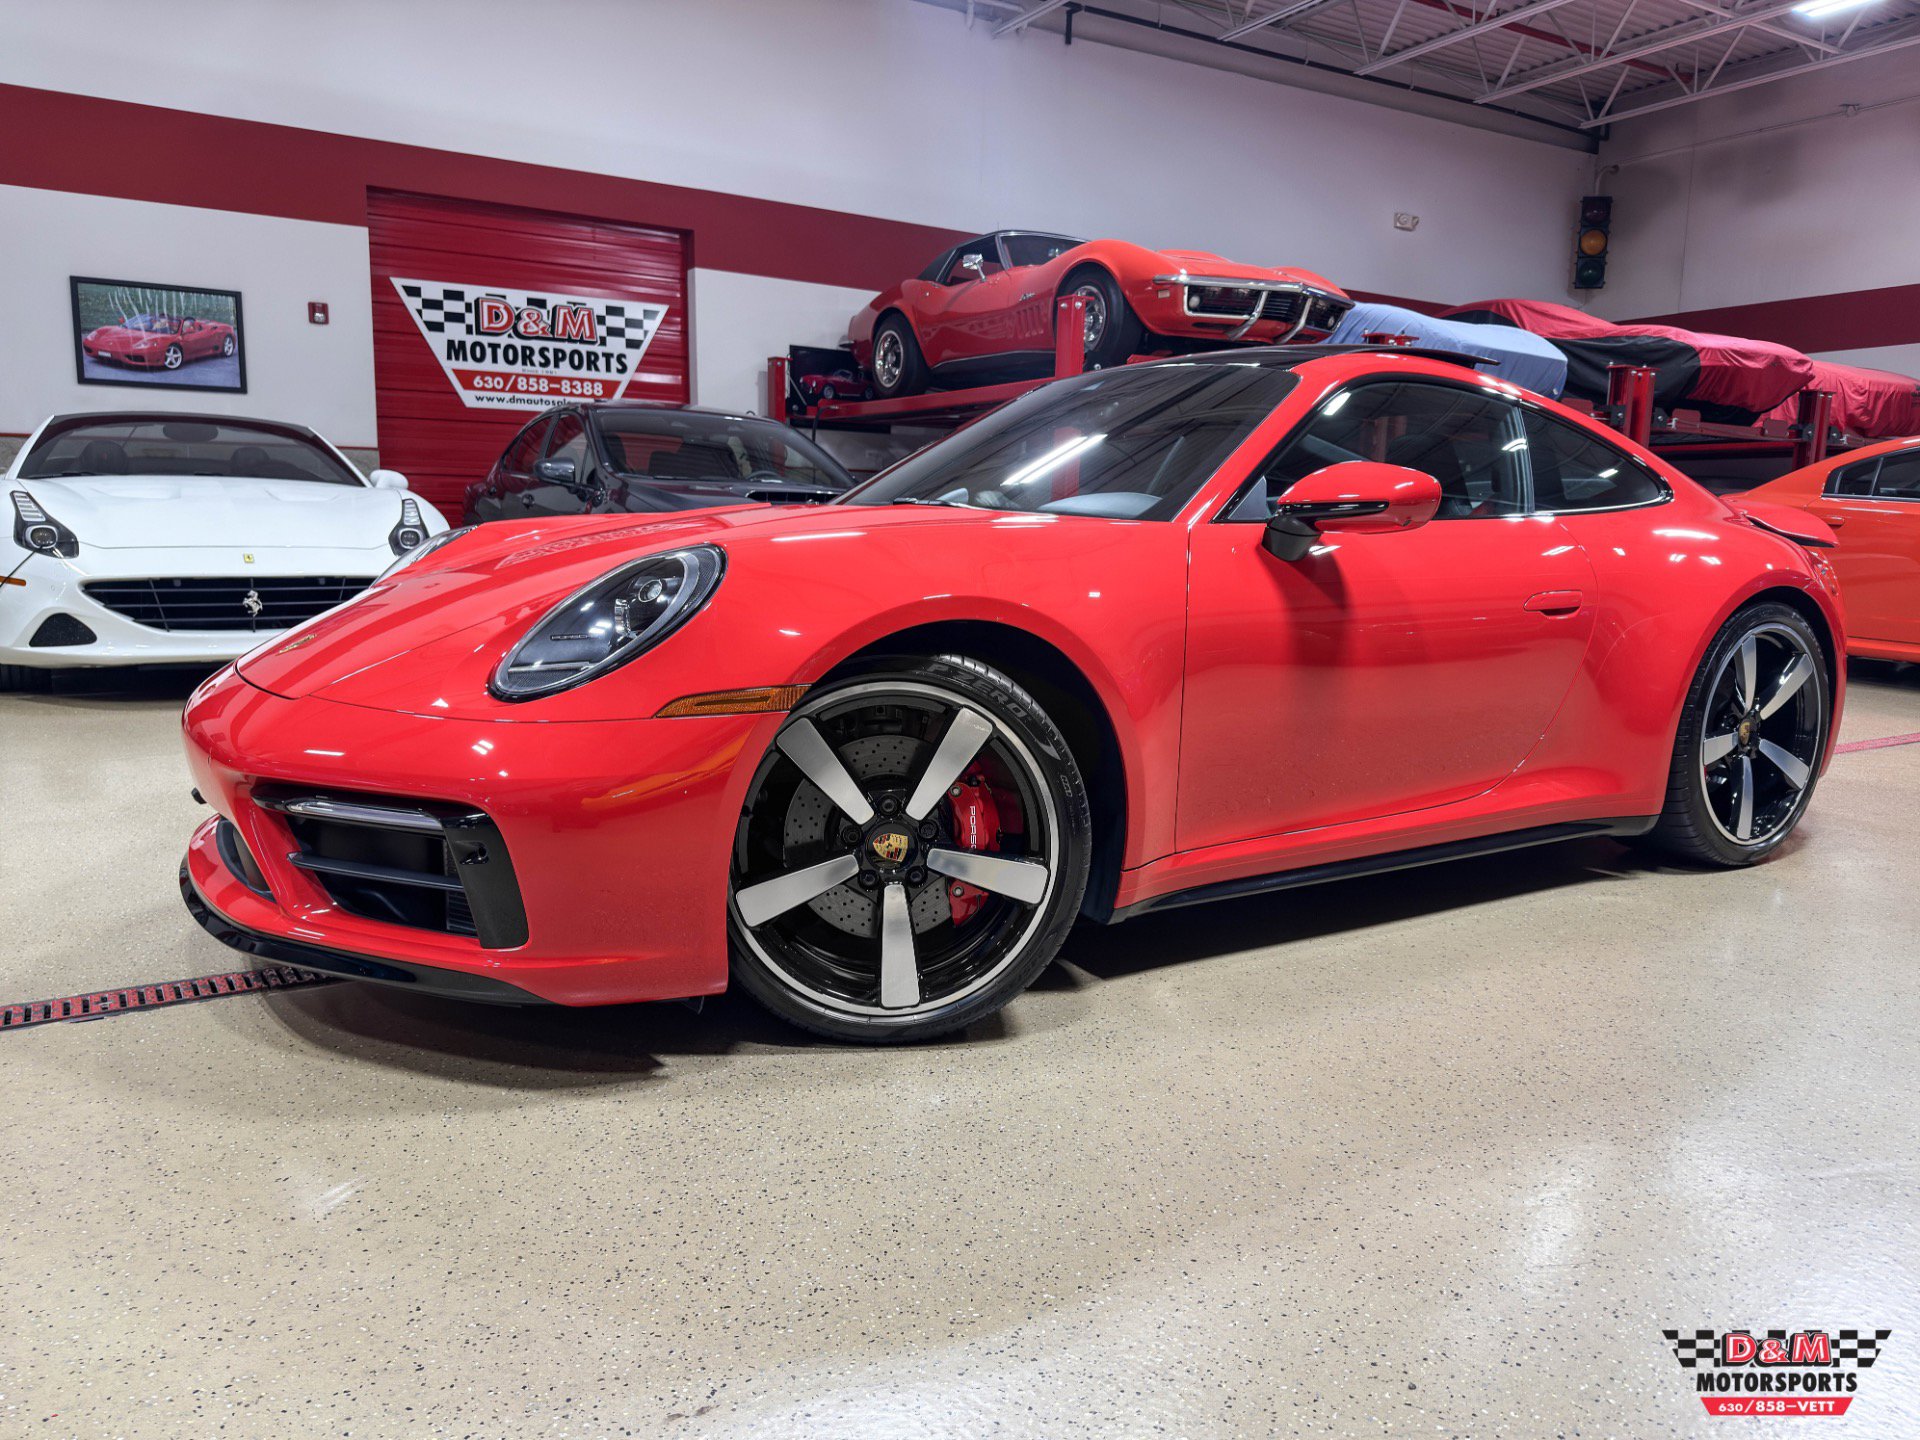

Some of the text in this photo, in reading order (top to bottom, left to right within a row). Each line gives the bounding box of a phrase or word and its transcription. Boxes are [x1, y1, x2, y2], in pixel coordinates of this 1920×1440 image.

[475, 297, 599, 344] D&M
[447, 340, 628, 374] MOTORSPORTS
[473, 376, 604, 397] 630/858-8388
